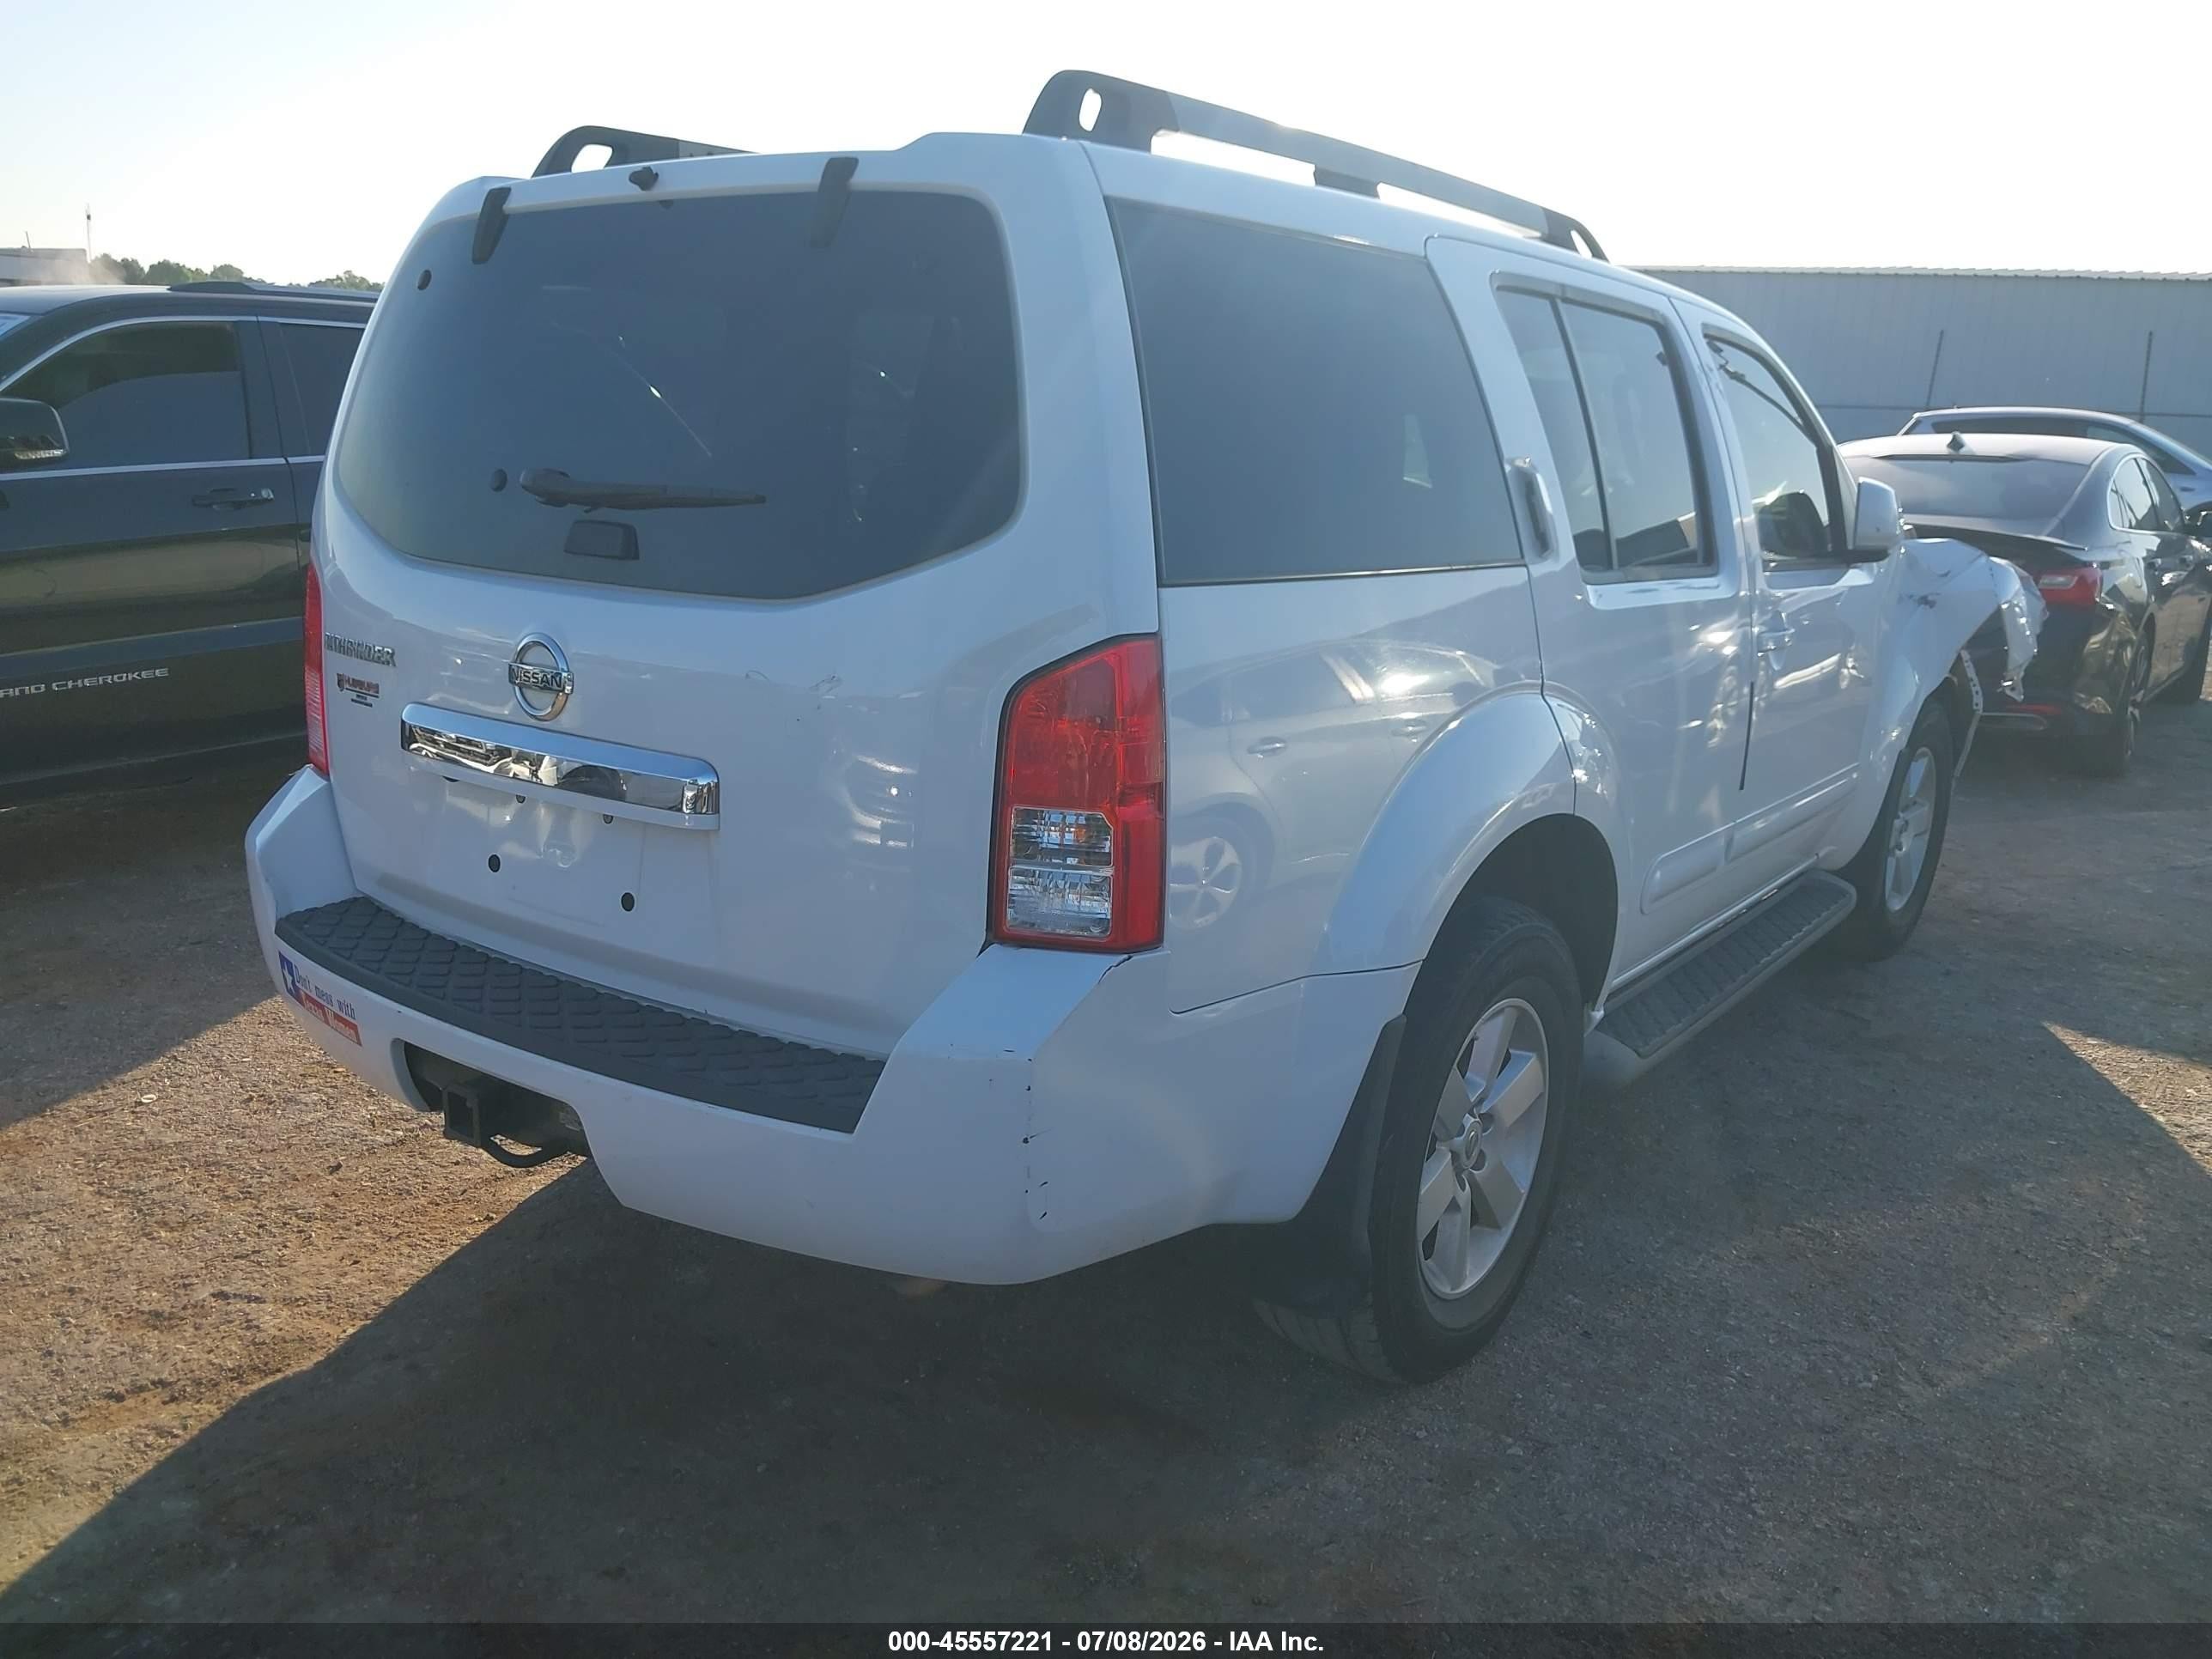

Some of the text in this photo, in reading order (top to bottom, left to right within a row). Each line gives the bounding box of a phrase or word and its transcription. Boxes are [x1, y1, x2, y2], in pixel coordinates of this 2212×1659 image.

[52, 668, 169, 690] CHEROKEE
[510, 666, 562, 689] NISSAN
[337, 999, 356, 1019] with
